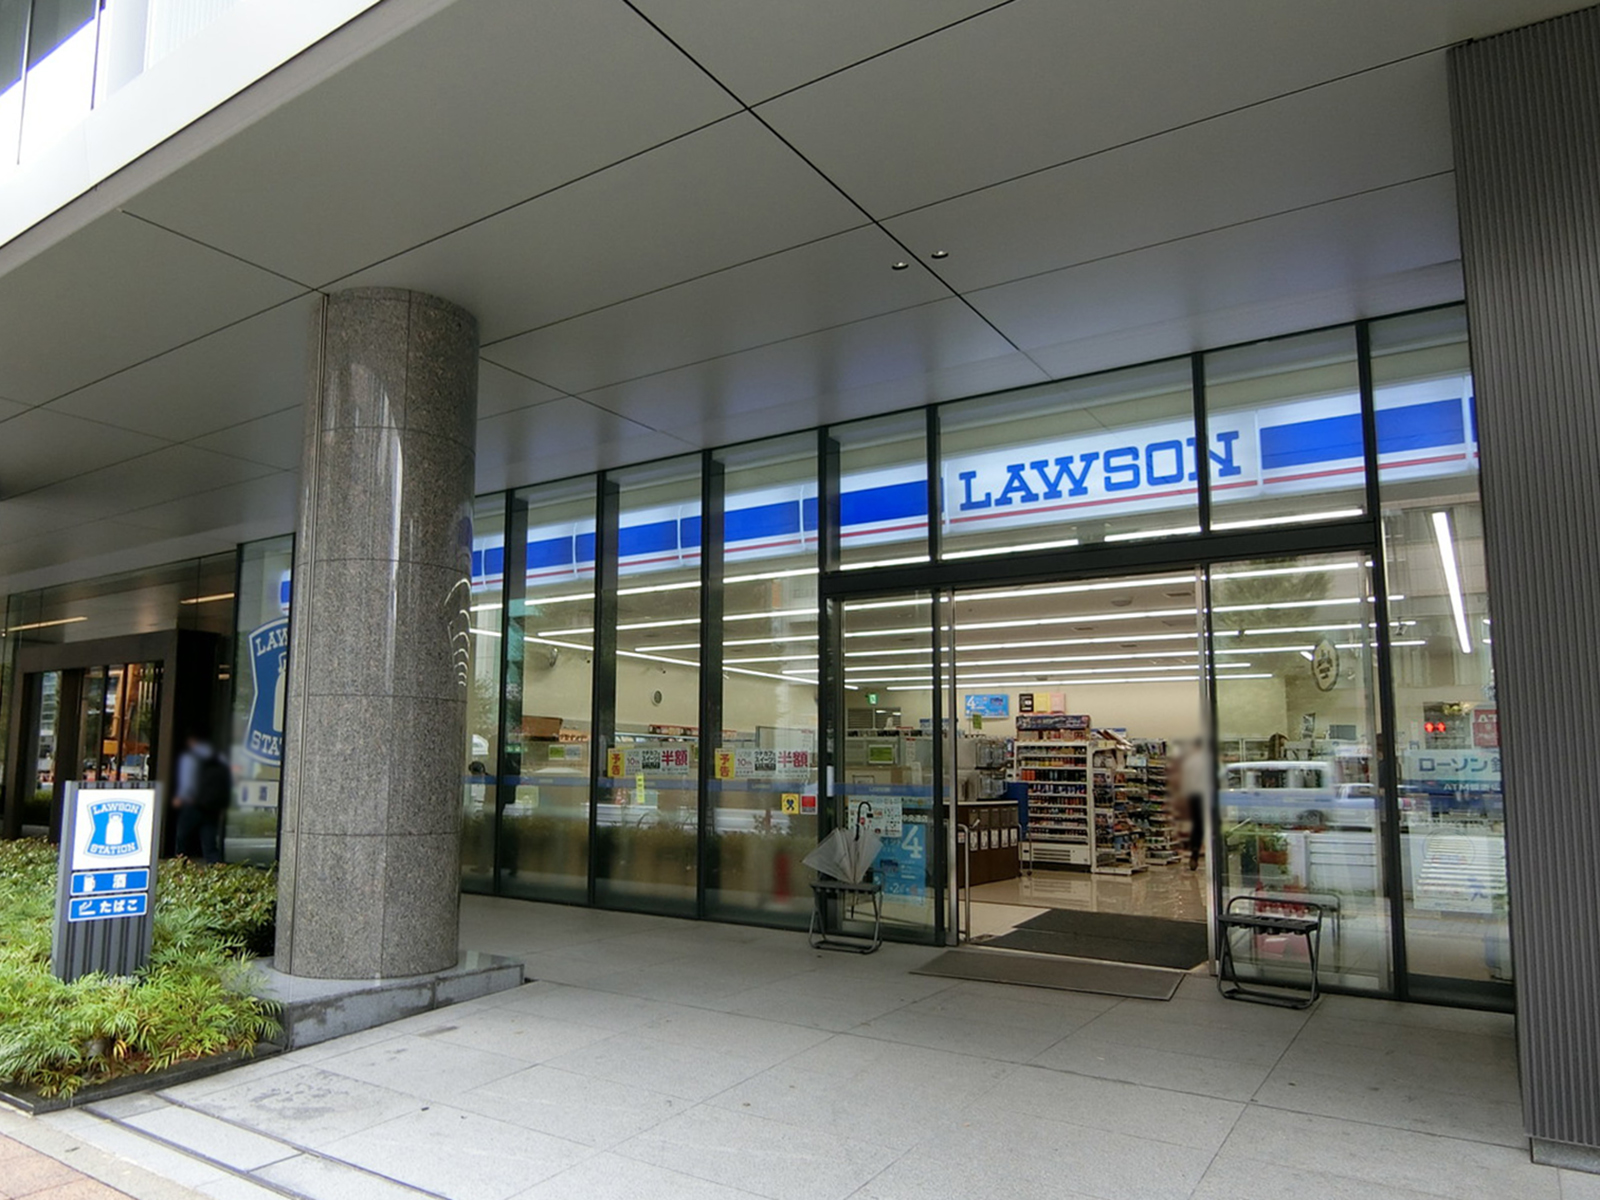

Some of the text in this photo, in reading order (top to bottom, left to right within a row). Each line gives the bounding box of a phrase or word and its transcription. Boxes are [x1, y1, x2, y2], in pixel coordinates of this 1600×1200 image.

[959, 430, 1241, 511] LAWSON
[250, 730, 282, 756] STA
[661, 750, 688, 766] 半額
[778, 750, 808, 768] 半額
[93, 802, 139, 815] LAWSON
[90, 842, 136, 855] STATION
[901, 825, 923, 858] 4
[99, 899, 138, 914] たばこ
